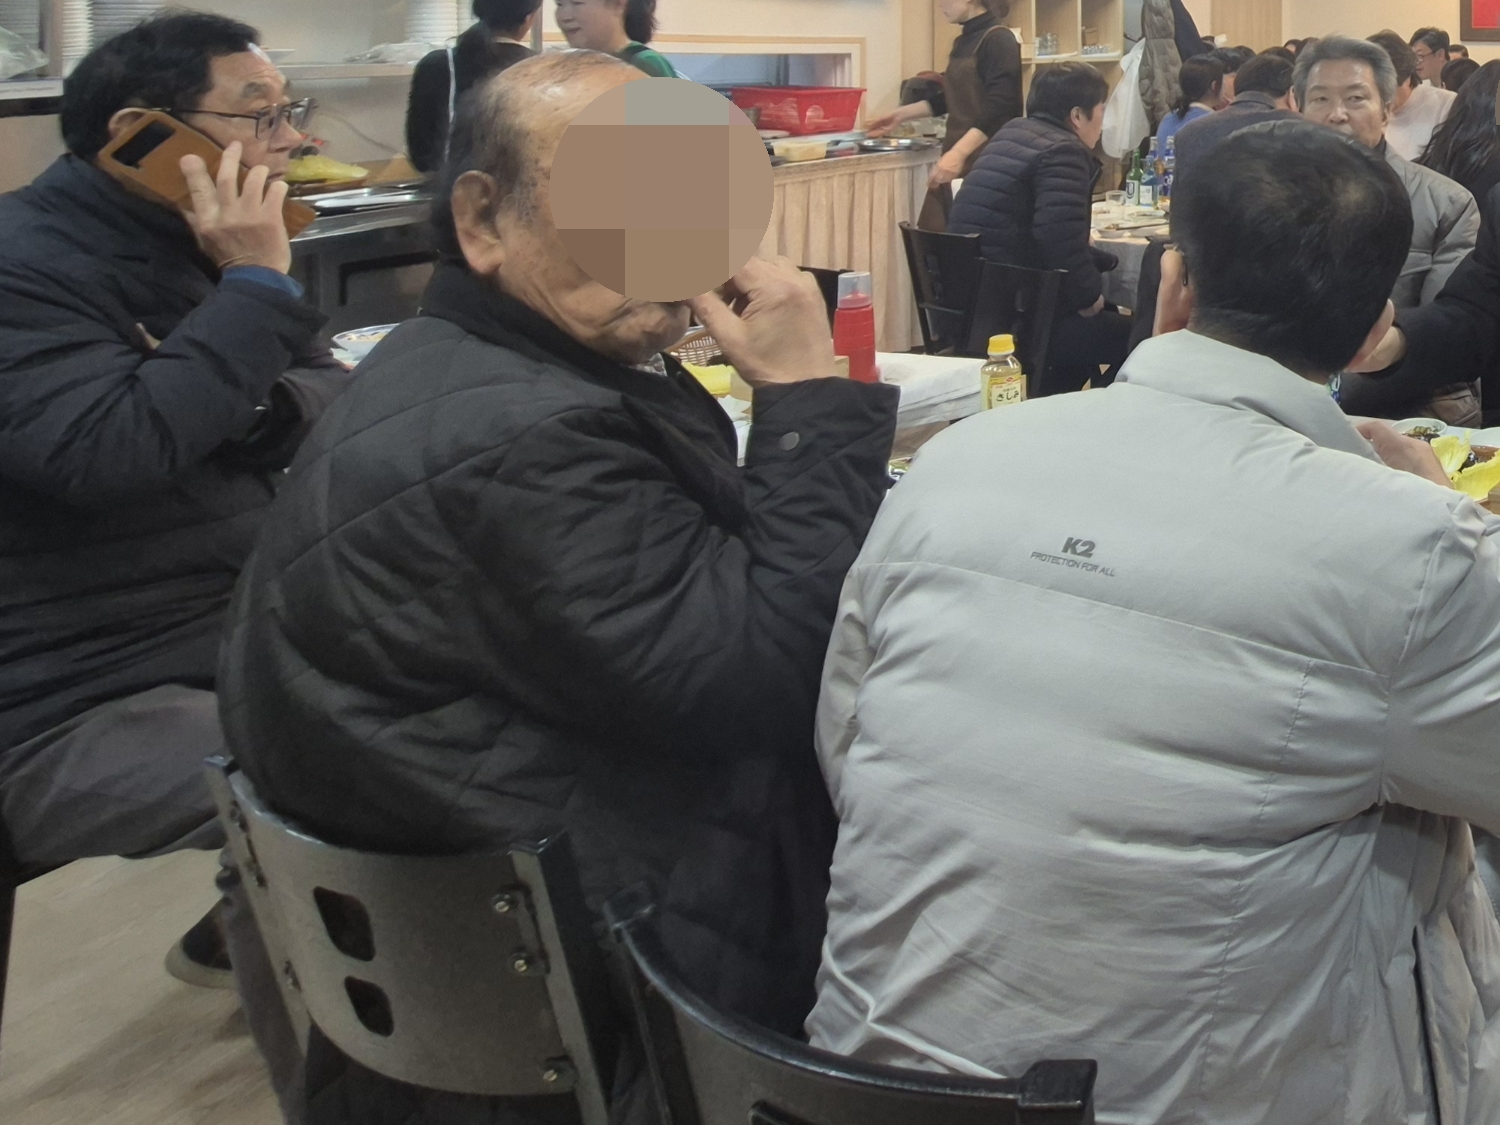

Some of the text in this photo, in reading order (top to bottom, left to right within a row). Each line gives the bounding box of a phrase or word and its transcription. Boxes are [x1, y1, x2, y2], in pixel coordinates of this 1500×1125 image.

[1061, 536, 1096, 559] K2
[1030, 551, 1116, 577] PROTECTION FOR ALL
